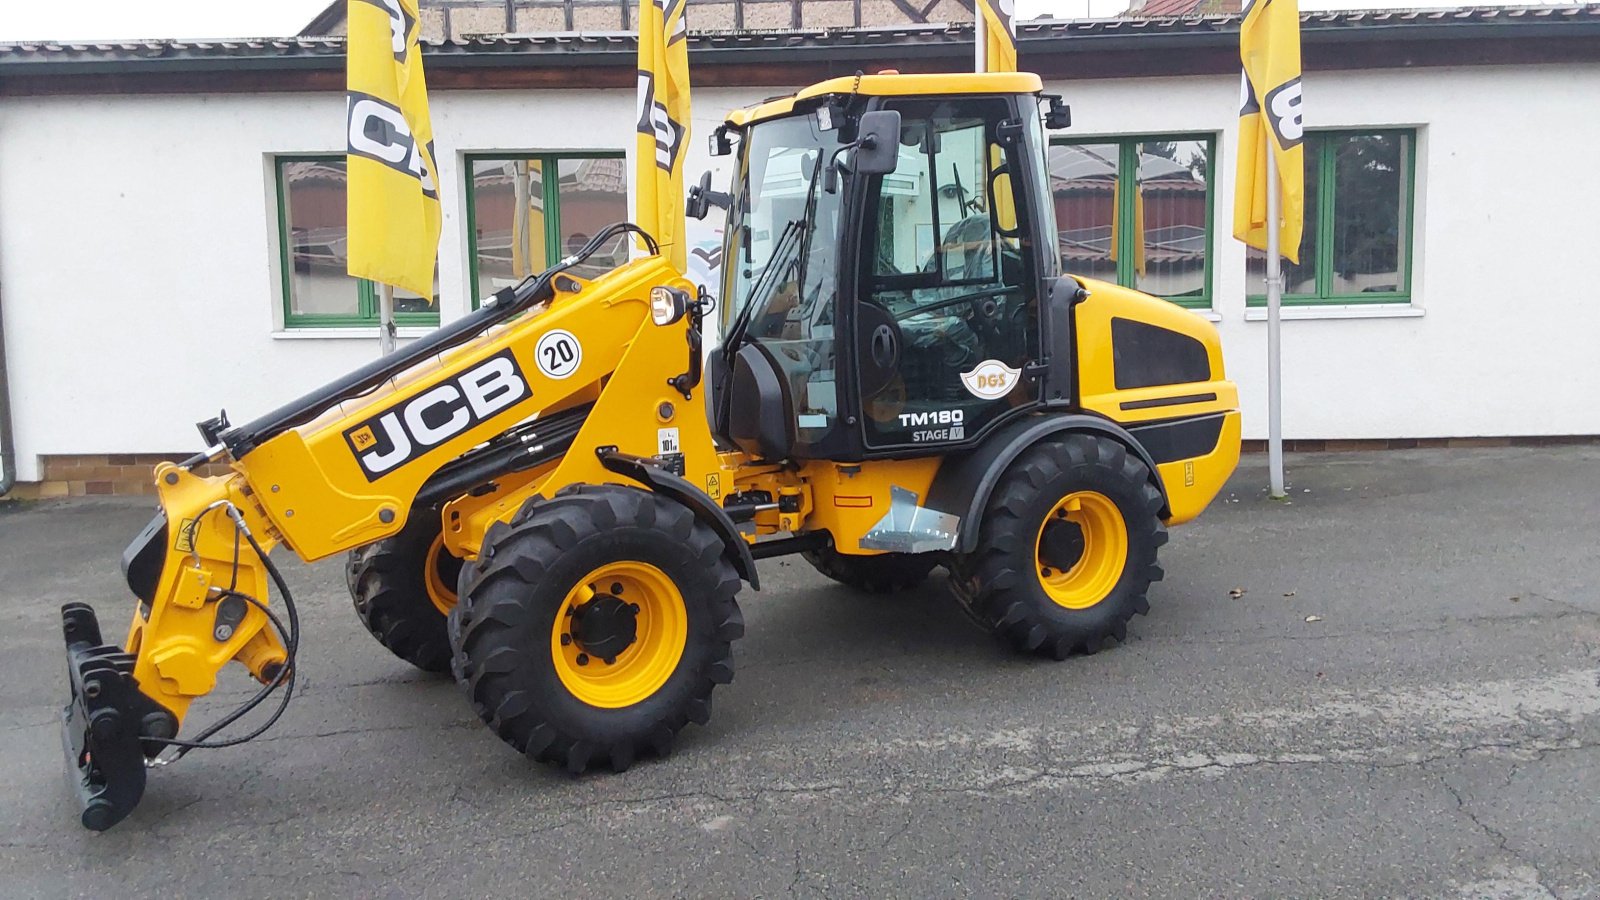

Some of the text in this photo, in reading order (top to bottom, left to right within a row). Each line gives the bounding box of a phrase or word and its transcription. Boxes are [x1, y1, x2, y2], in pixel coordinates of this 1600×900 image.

[544, 340, 574, 370] 20
[977, 373, 1006, 389] DGS
[362, 356, 525, 473] JCB
[898, 409, 963, 426] TM180
[913, 429, 948, 441] STAGE
[662, 439, 673, 451] 101
